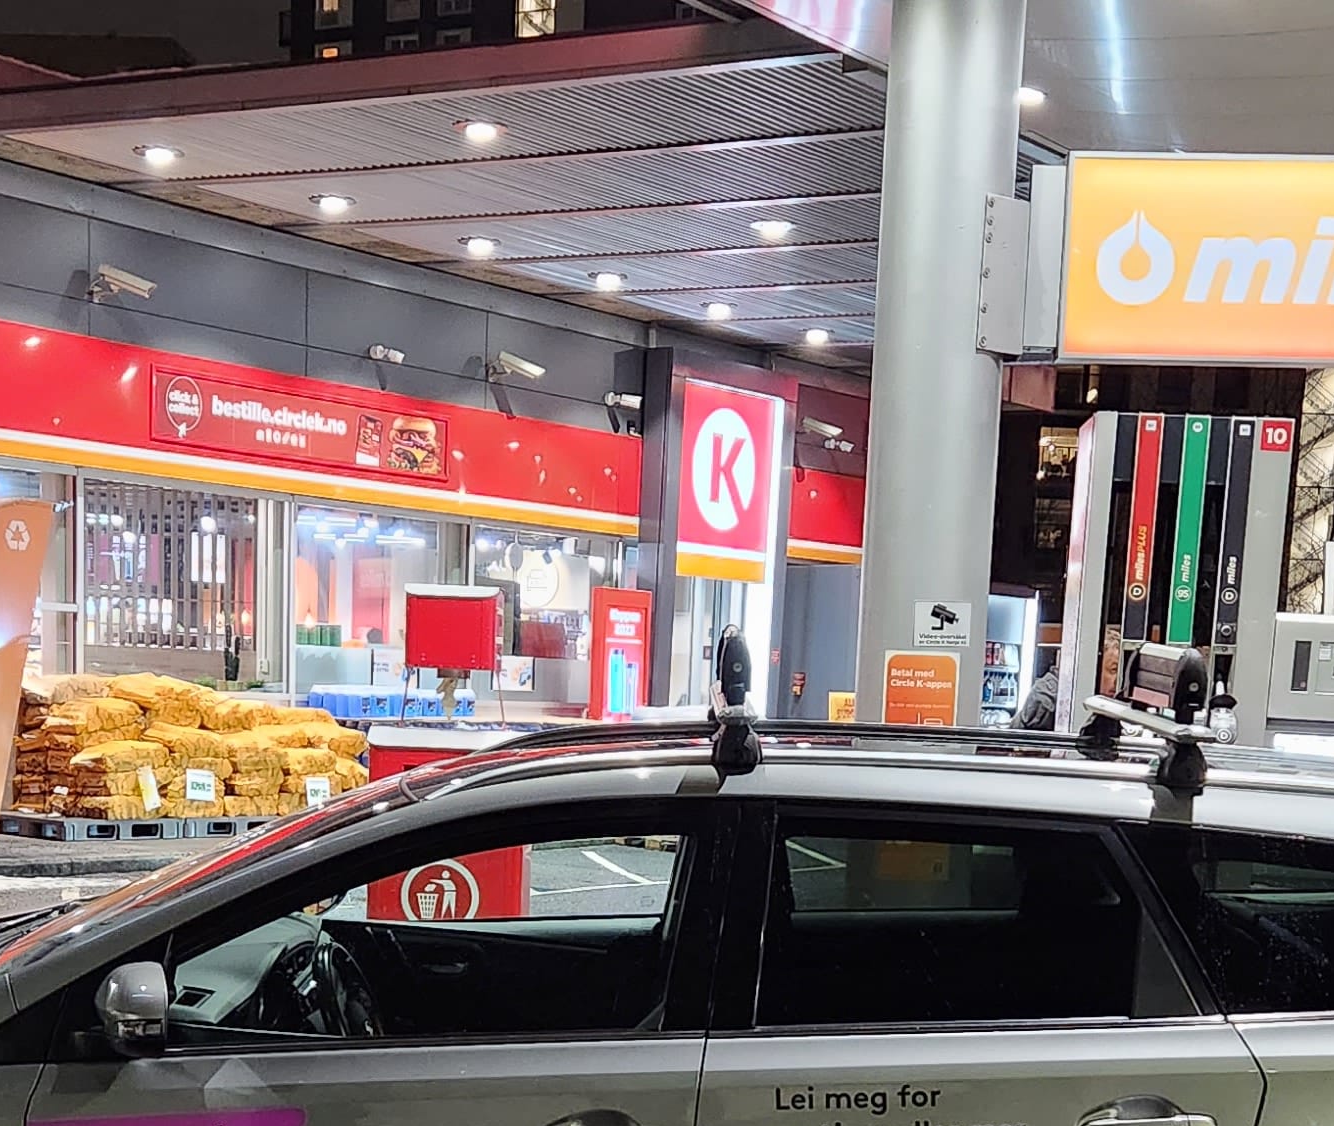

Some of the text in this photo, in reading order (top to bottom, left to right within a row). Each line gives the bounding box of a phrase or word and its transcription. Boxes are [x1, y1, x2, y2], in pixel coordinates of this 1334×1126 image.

[210, 394, 348, 436] bestille.circlek.no
[1265, 427, 1289, 445] 10
[1134, 525, 1148, 581] milesPLUS
[1181, 554, 1192, 583] miles
[1226, 556, 1238, 585] miles
[890, 667, 935, 678] Betal med
[890, 678, 915, 688] Circle
[775, 1084, 941, 1116] Lei meg for
